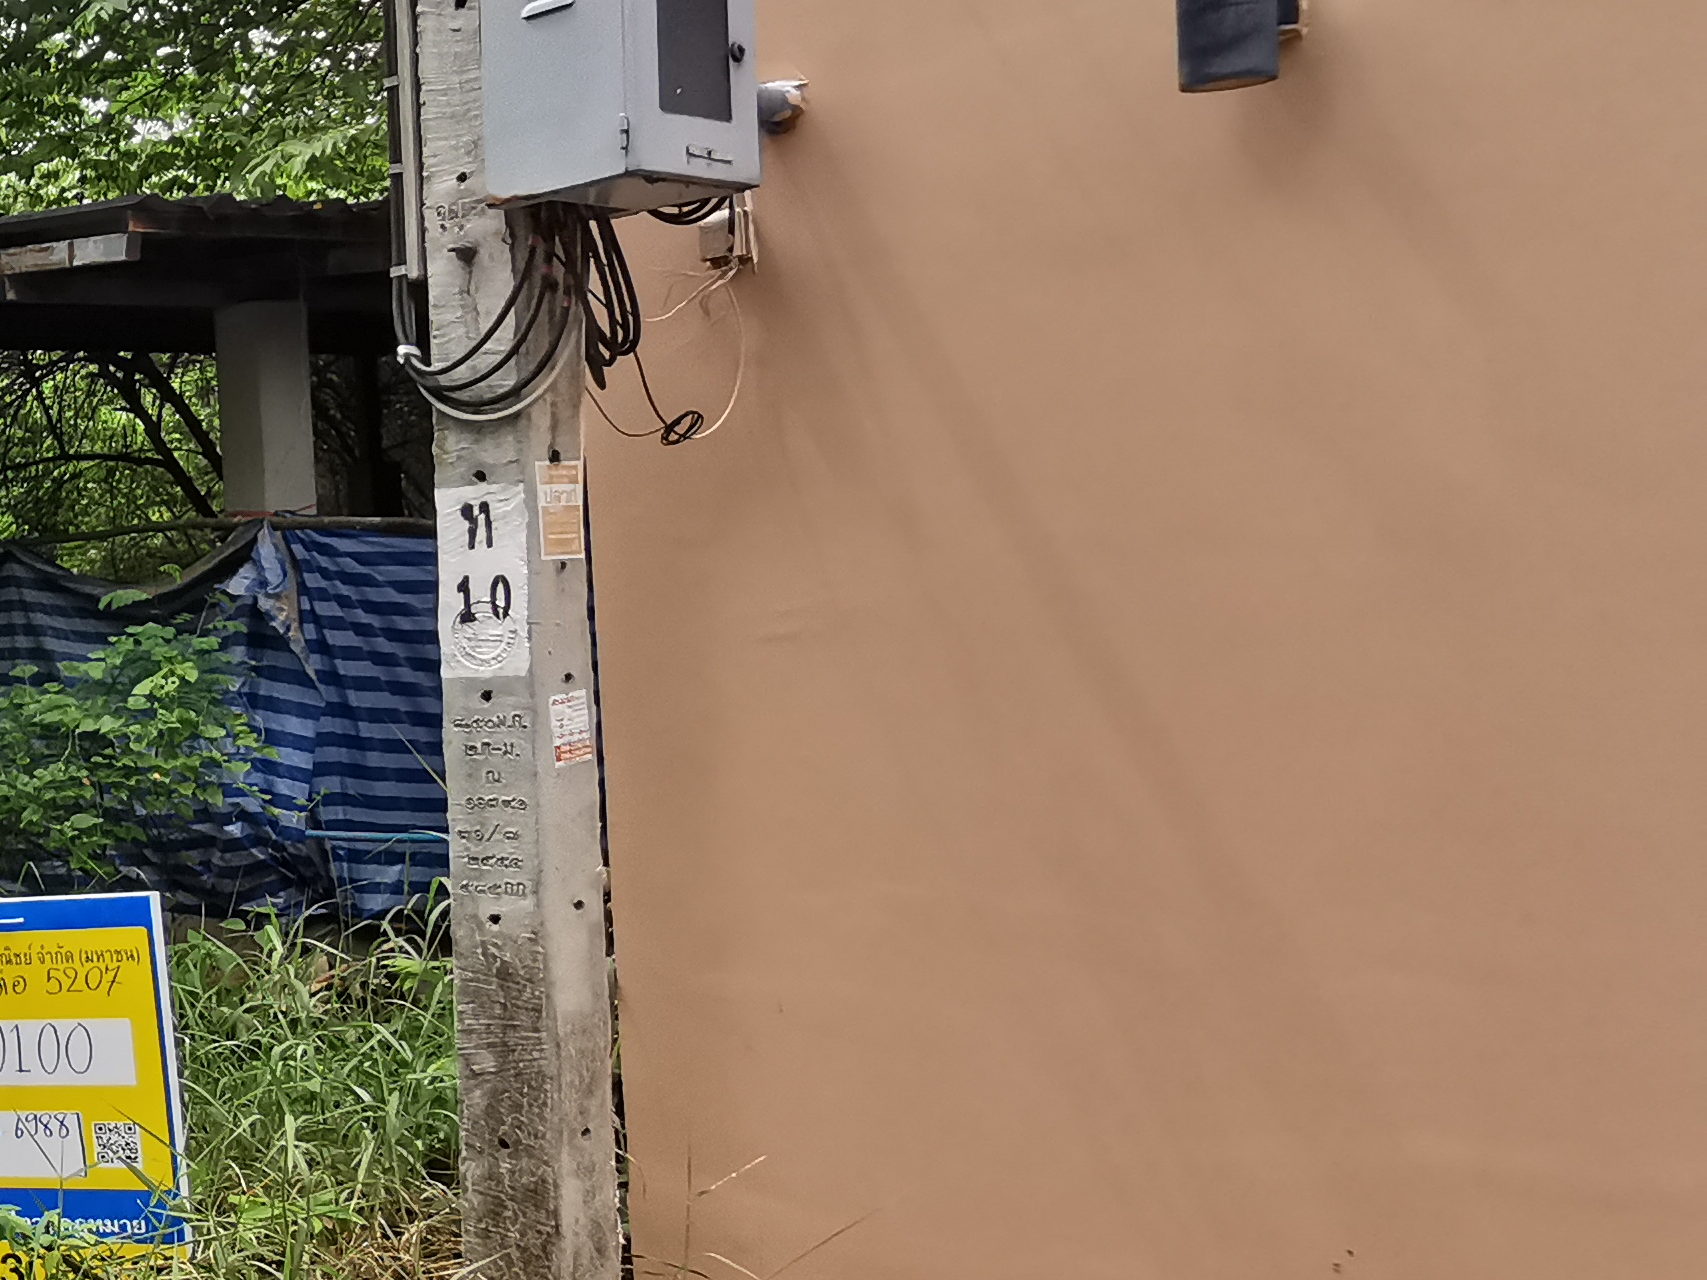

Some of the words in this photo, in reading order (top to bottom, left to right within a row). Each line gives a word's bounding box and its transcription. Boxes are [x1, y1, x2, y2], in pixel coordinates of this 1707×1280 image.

[37, 942, 75, 966] จำกัด
[79, 946, 141, 968] (มหาชน)
[45, 964, 123, 998] 5207
